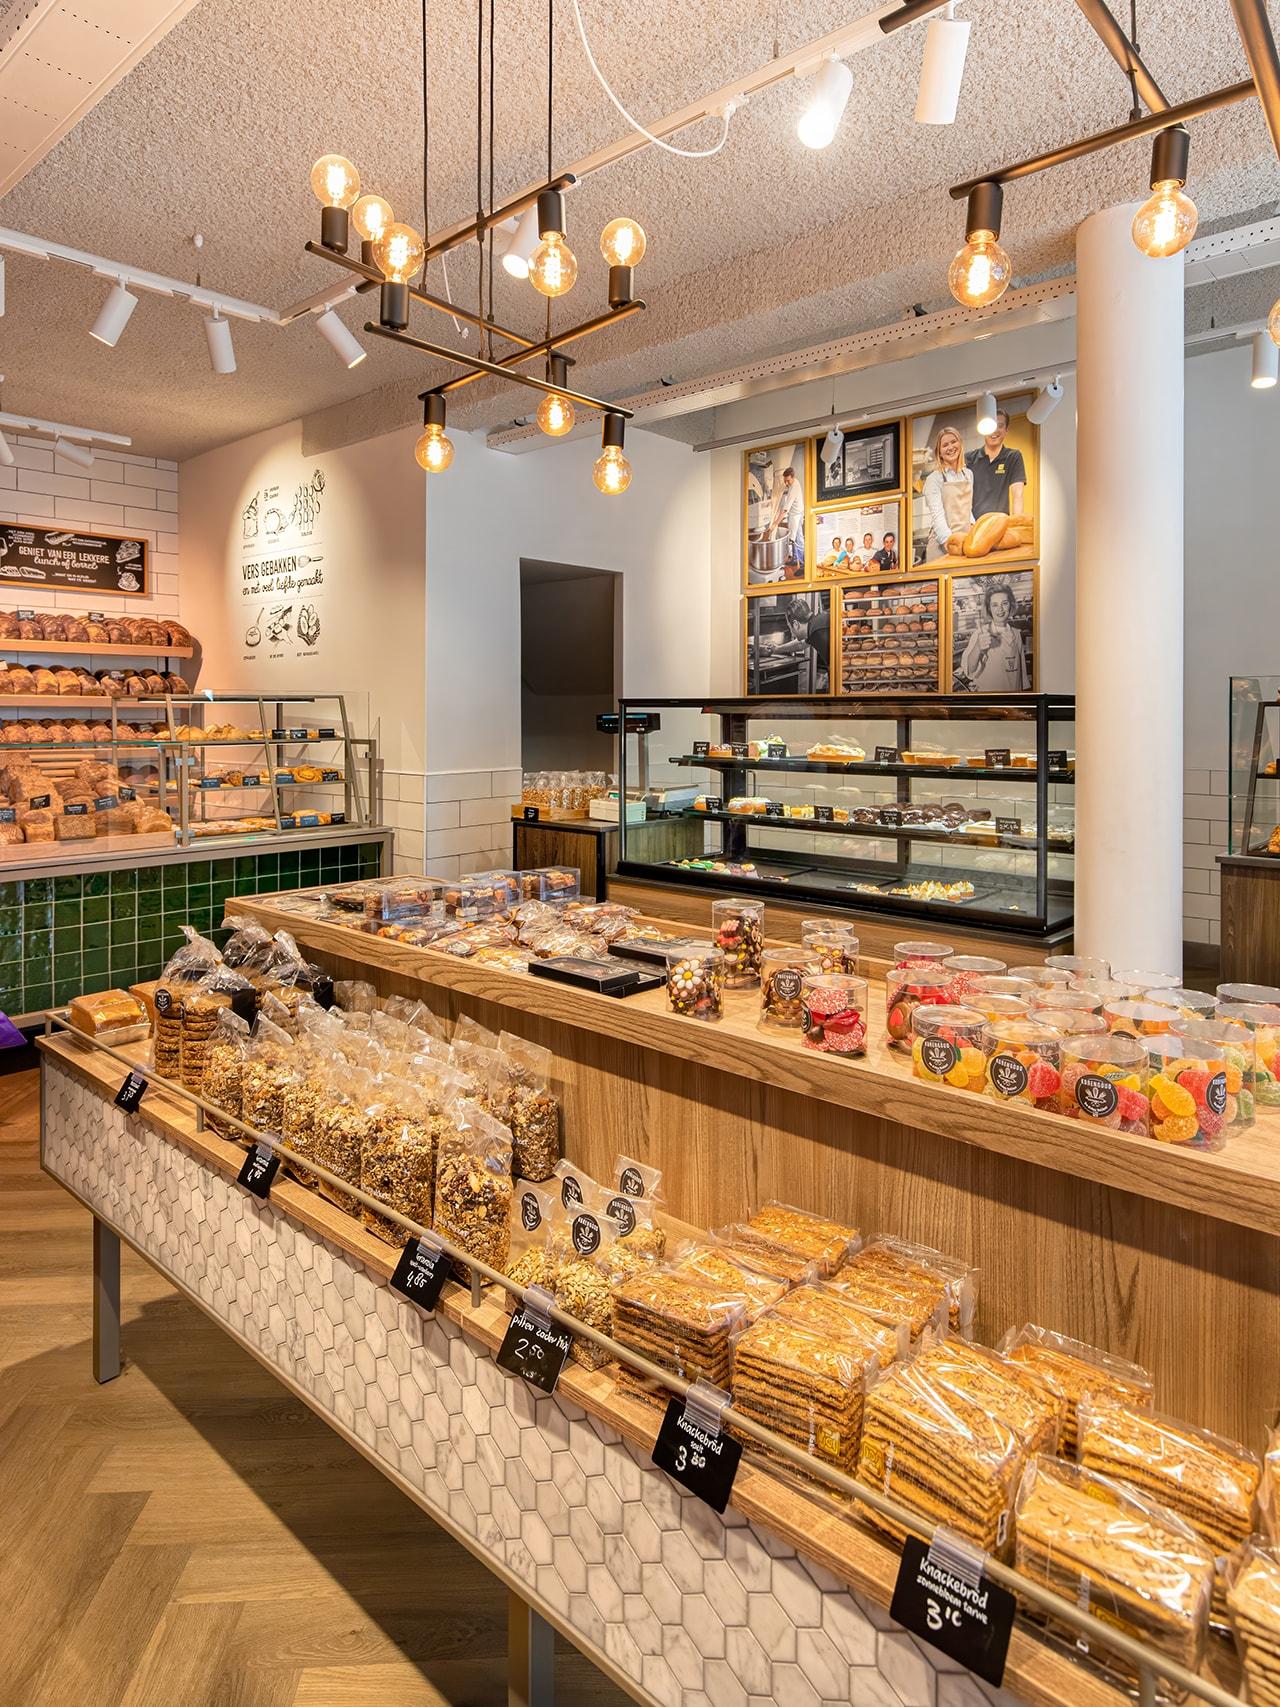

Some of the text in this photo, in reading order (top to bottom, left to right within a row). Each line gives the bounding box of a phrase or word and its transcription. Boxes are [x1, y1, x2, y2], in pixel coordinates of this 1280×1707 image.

[18, 546, 110, 564] GENIET VAN EEN LEKKERE
[34, 556, 61, 566] lunch
[61, 559, 71, 570] of
[242, 555, 297, 581] VERS GEBAKKEN
[242, 587, 250, 595] en
[276, 575, 297, 594] liefde
[297, 568, 324, 593] gemaakt
[963, 1602, 988, 1625] tarwe
